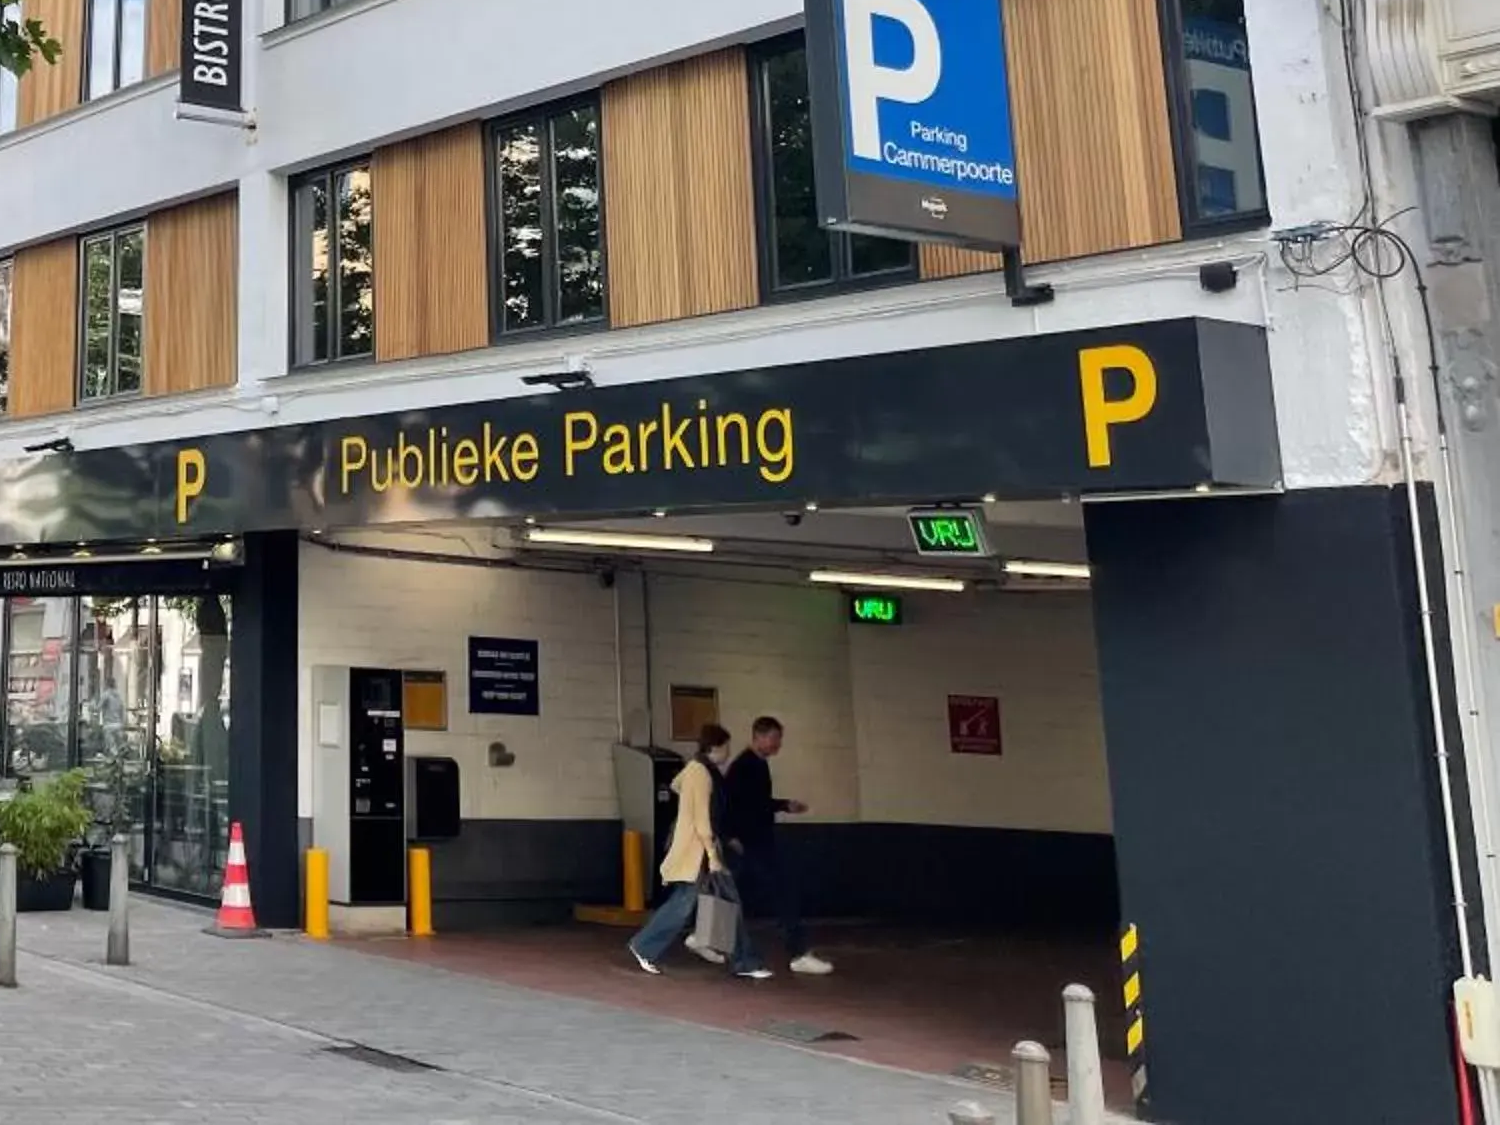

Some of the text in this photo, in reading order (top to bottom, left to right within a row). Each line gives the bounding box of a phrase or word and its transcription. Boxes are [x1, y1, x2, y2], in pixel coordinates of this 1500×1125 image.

[883, 141, 1014, 185] Cammerpoorte
[910, 120, 968, 152] Parking
[1079, 344, 1157, 468] P
[341, 398, 794, 495] Publieke Parking
[177, 448, 206, 524] P
